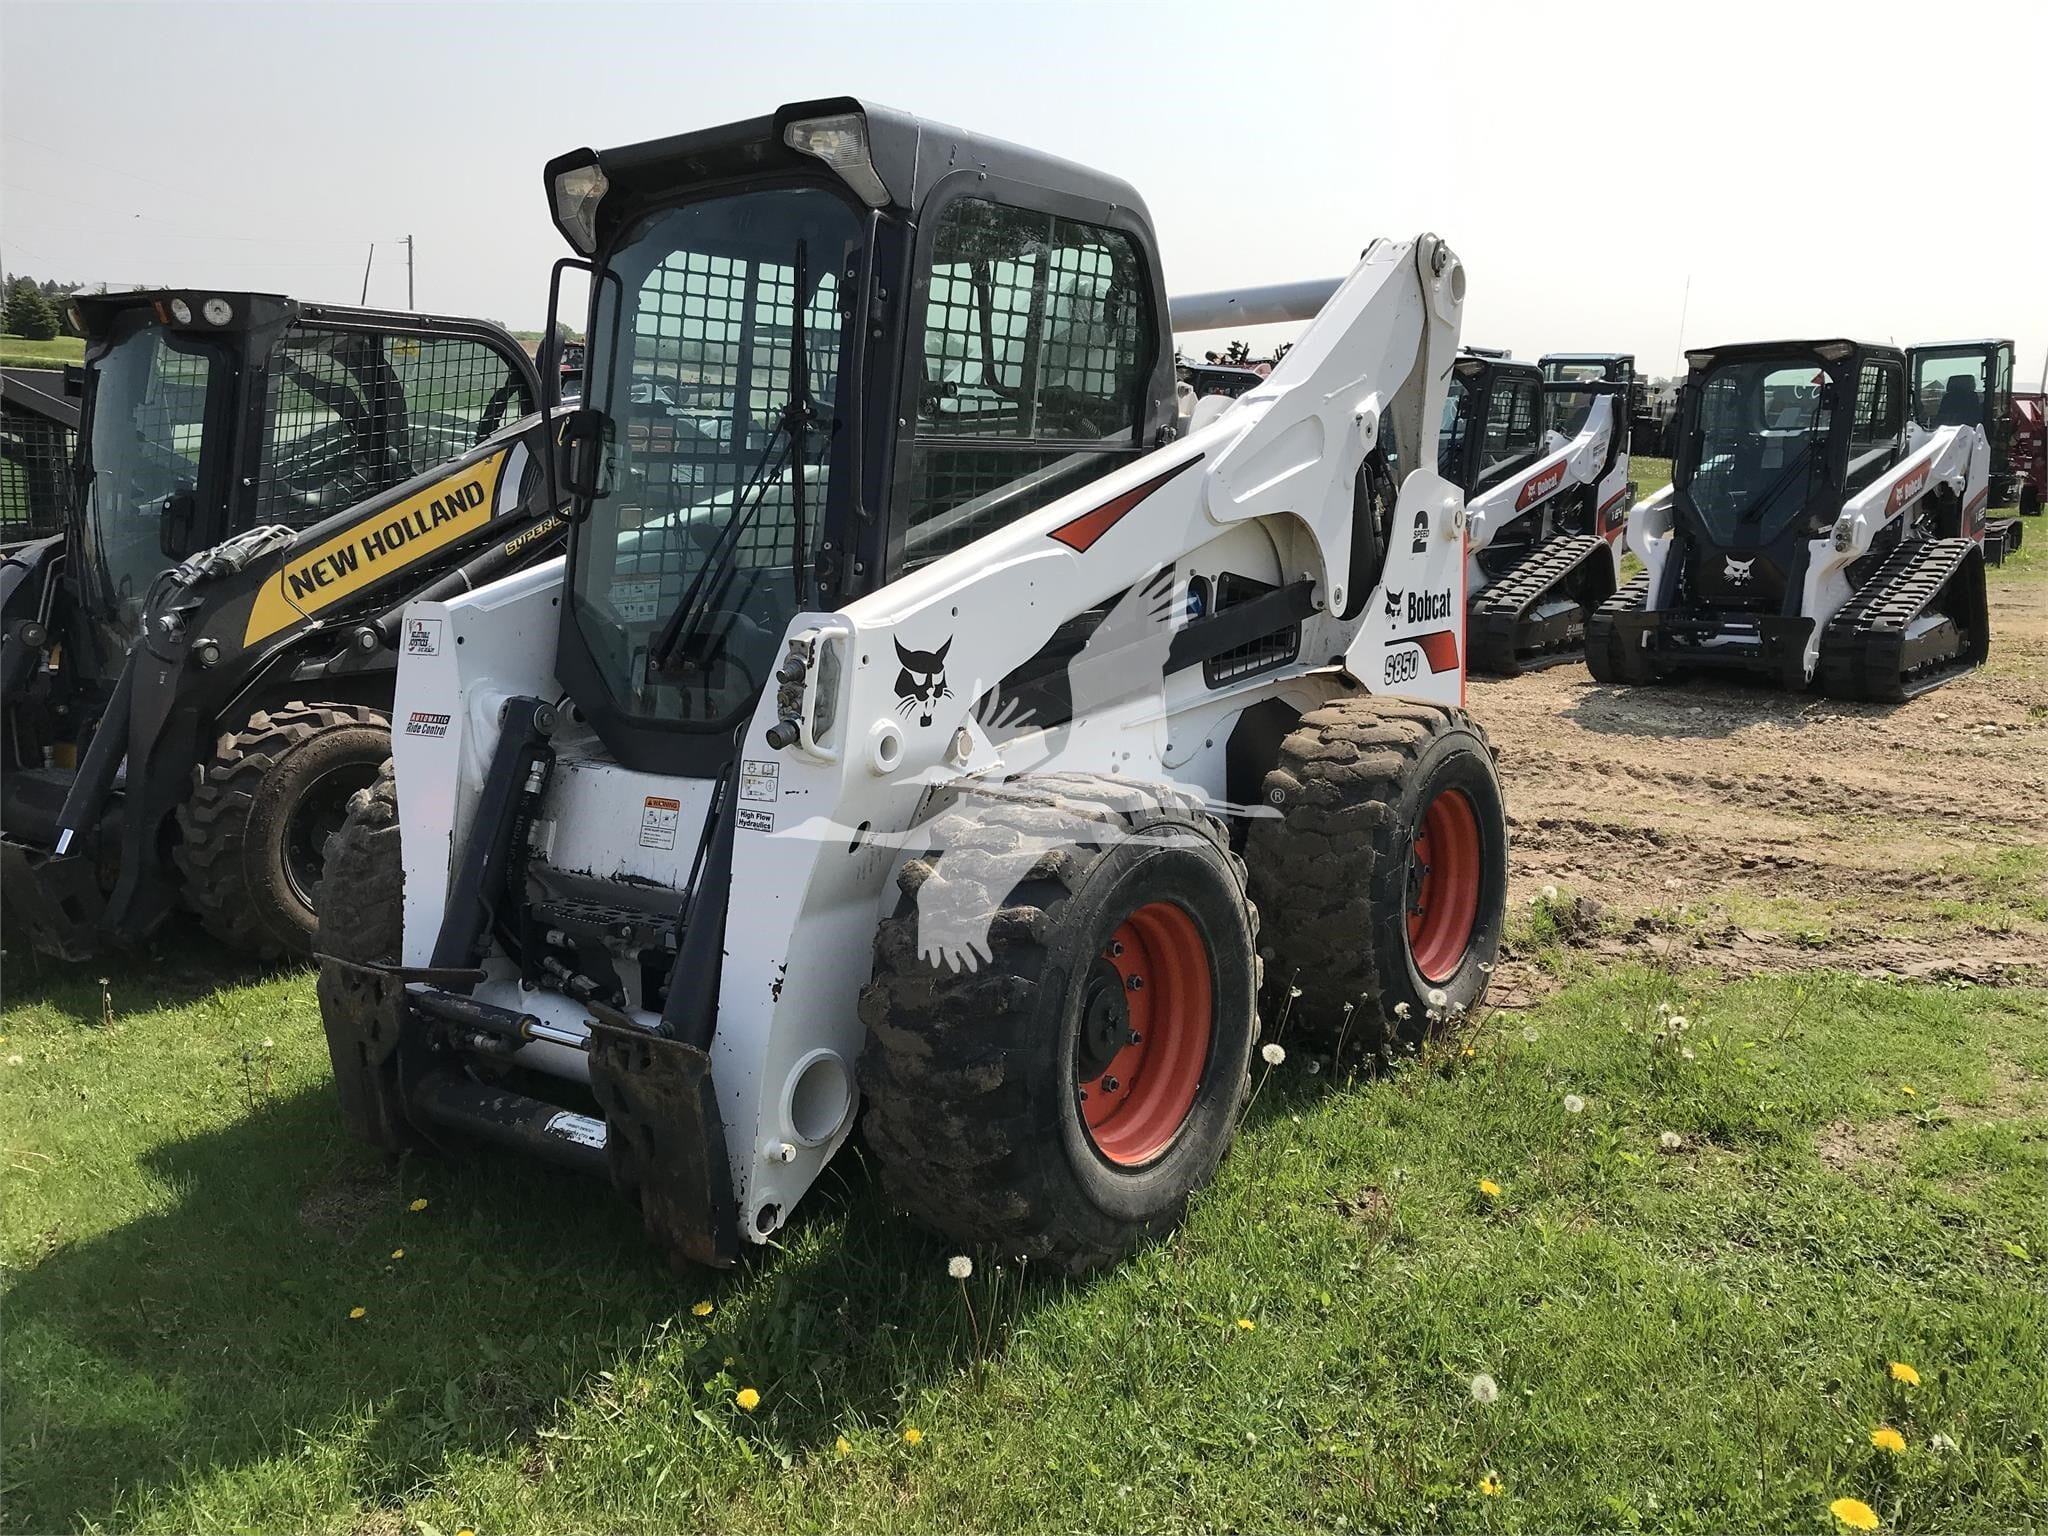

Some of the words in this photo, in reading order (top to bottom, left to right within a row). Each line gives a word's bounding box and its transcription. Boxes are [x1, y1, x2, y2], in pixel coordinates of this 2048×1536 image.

[288, 544, 359, 601] NEW
[360, 480, 486, 563] HOLLAND
[1413, 528, 1431, 540] SPEED
[1408, 587, 1452, 624] Bobcat
[1383, 650, 1419, 686] S850
[410, 713, 450, 724] AUTOMATIC
[405, 721, 422, 734] Ride
[421, 723, 448, 736] Control
[740, 811, 755, 821] High
[755, 812, 771, 822] Flow
[738, 818, 771, 830] Hydraulics
